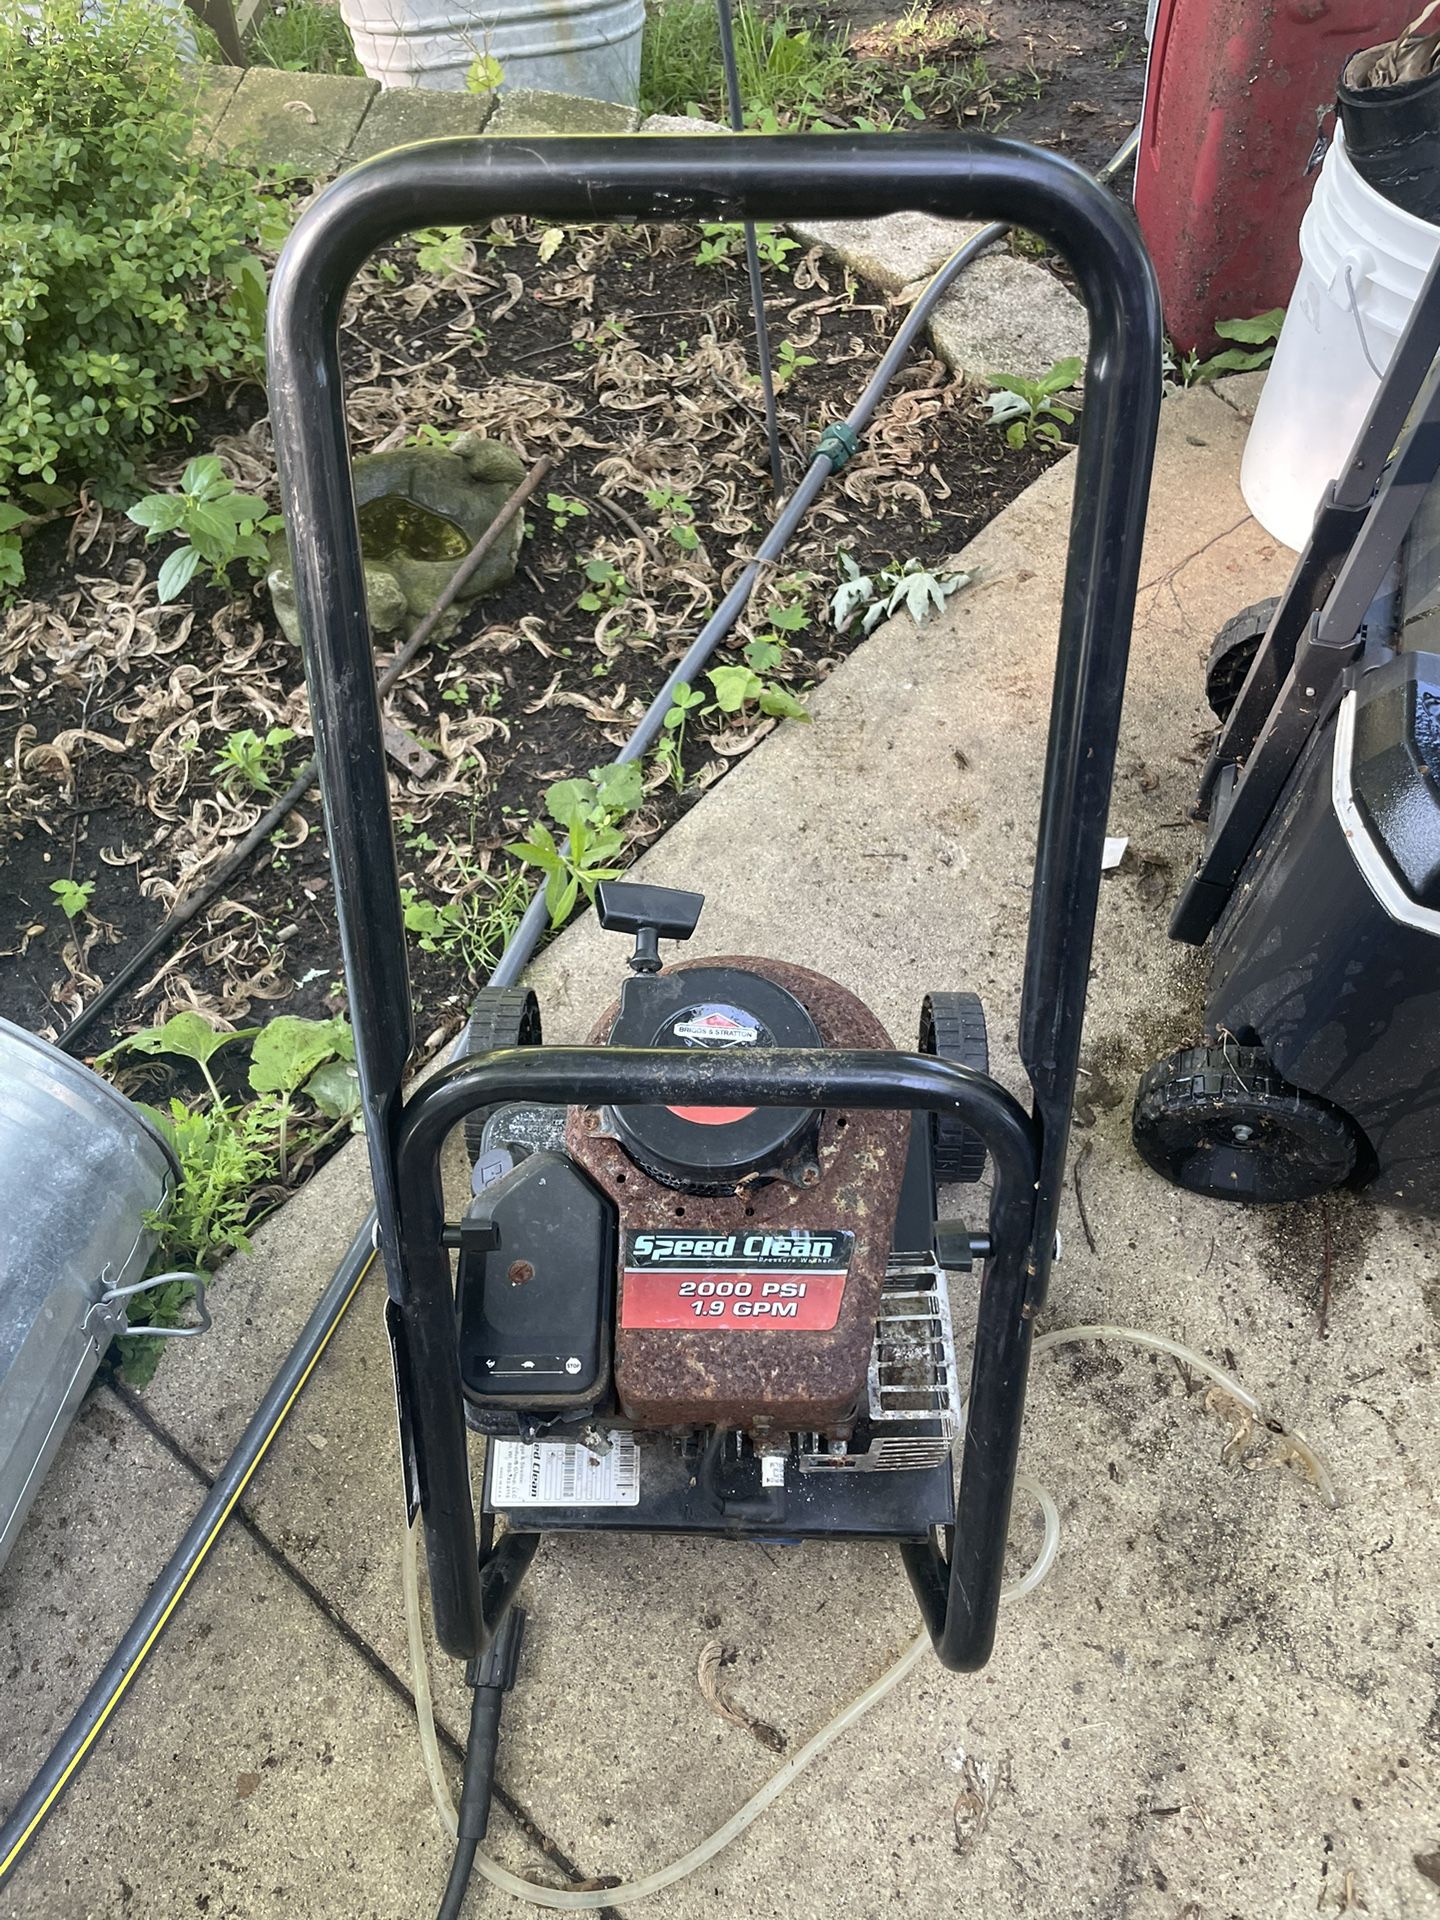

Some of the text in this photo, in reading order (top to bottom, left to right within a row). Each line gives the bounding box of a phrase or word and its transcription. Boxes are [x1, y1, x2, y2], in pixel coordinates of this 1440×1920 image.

[678, 1026, 707, 1034] BRIGGS
[715, 1029, 753, 1038] STRATTON
[633, 1235, 833, 1260] Speed Clean
[678, 1282, 807, 1298] 2000 PSI
[690, 1300, 798, 1317] 1.9 GPM
[531, 1462, 541, 1498] Clean
